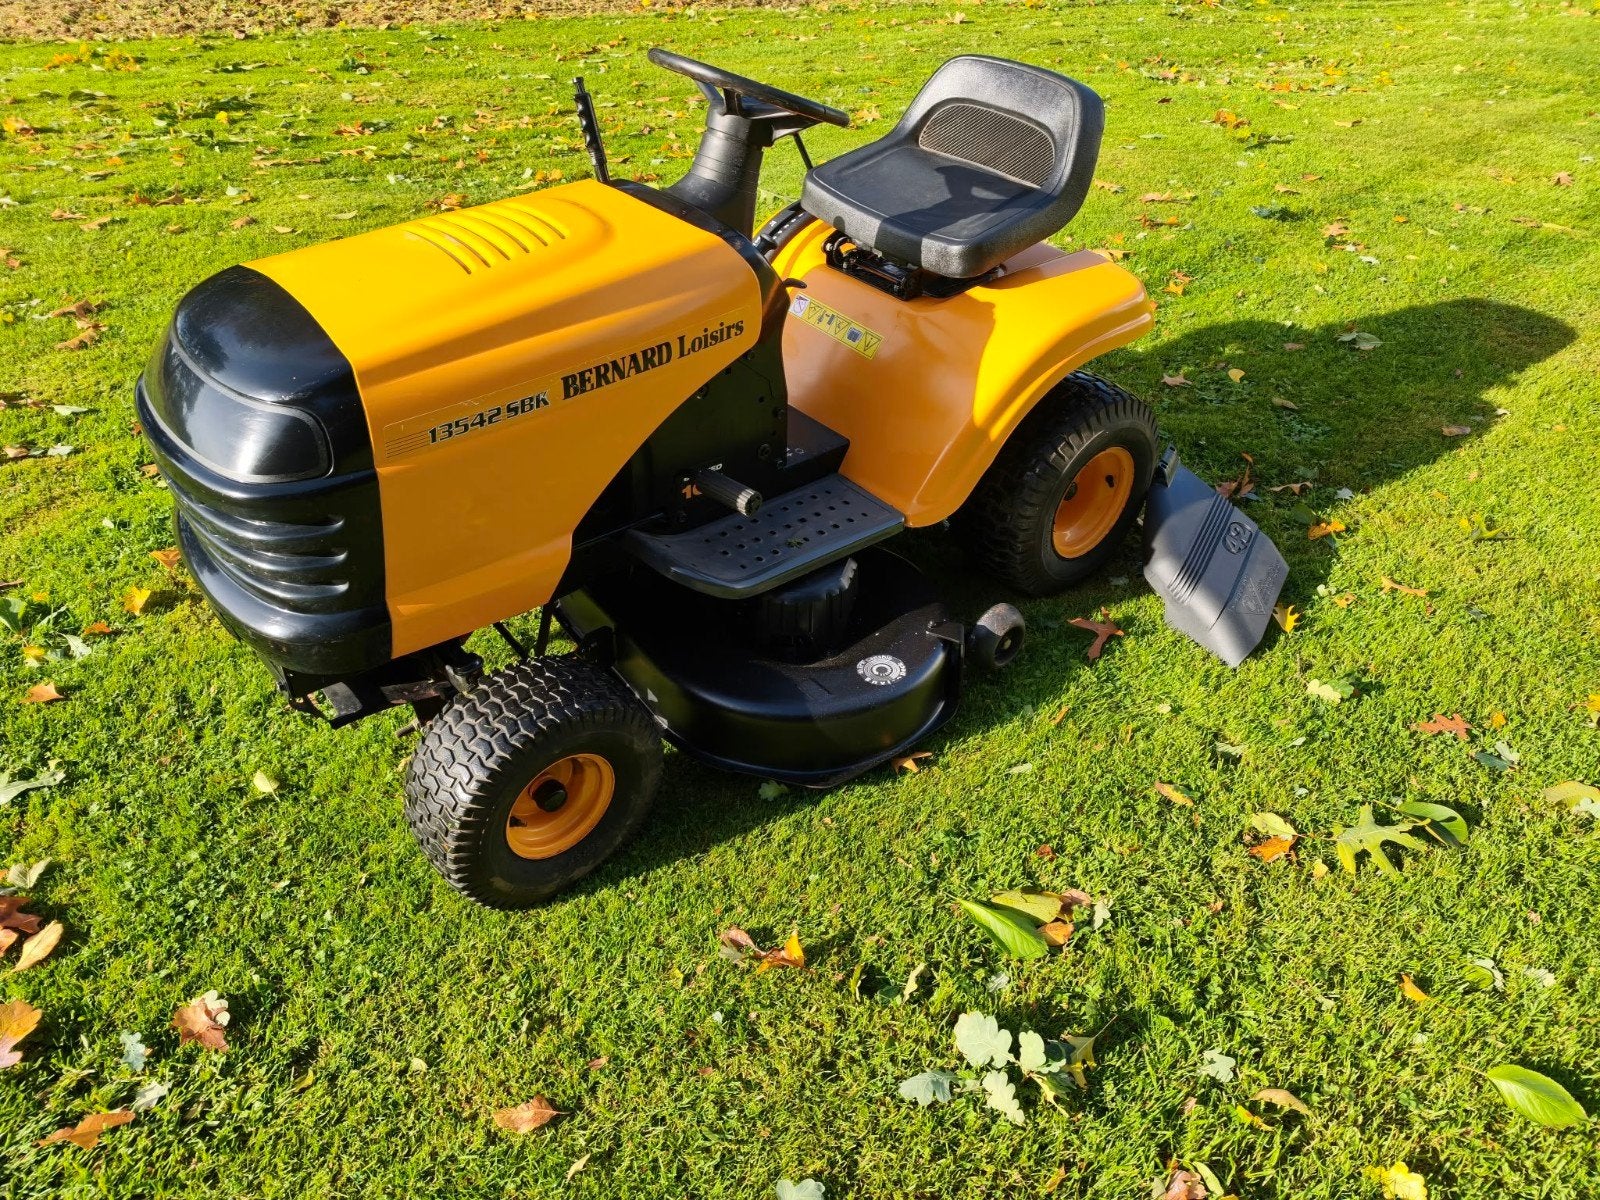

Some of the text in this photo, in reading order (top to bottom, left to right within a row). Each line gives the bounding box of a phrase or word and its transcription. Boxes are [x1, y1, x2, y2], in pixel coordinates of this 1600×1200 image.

[428, 320, 744, 444] 13542 SBK BERNARD Loisirs
[1226, 523, 1251, 553] 42
